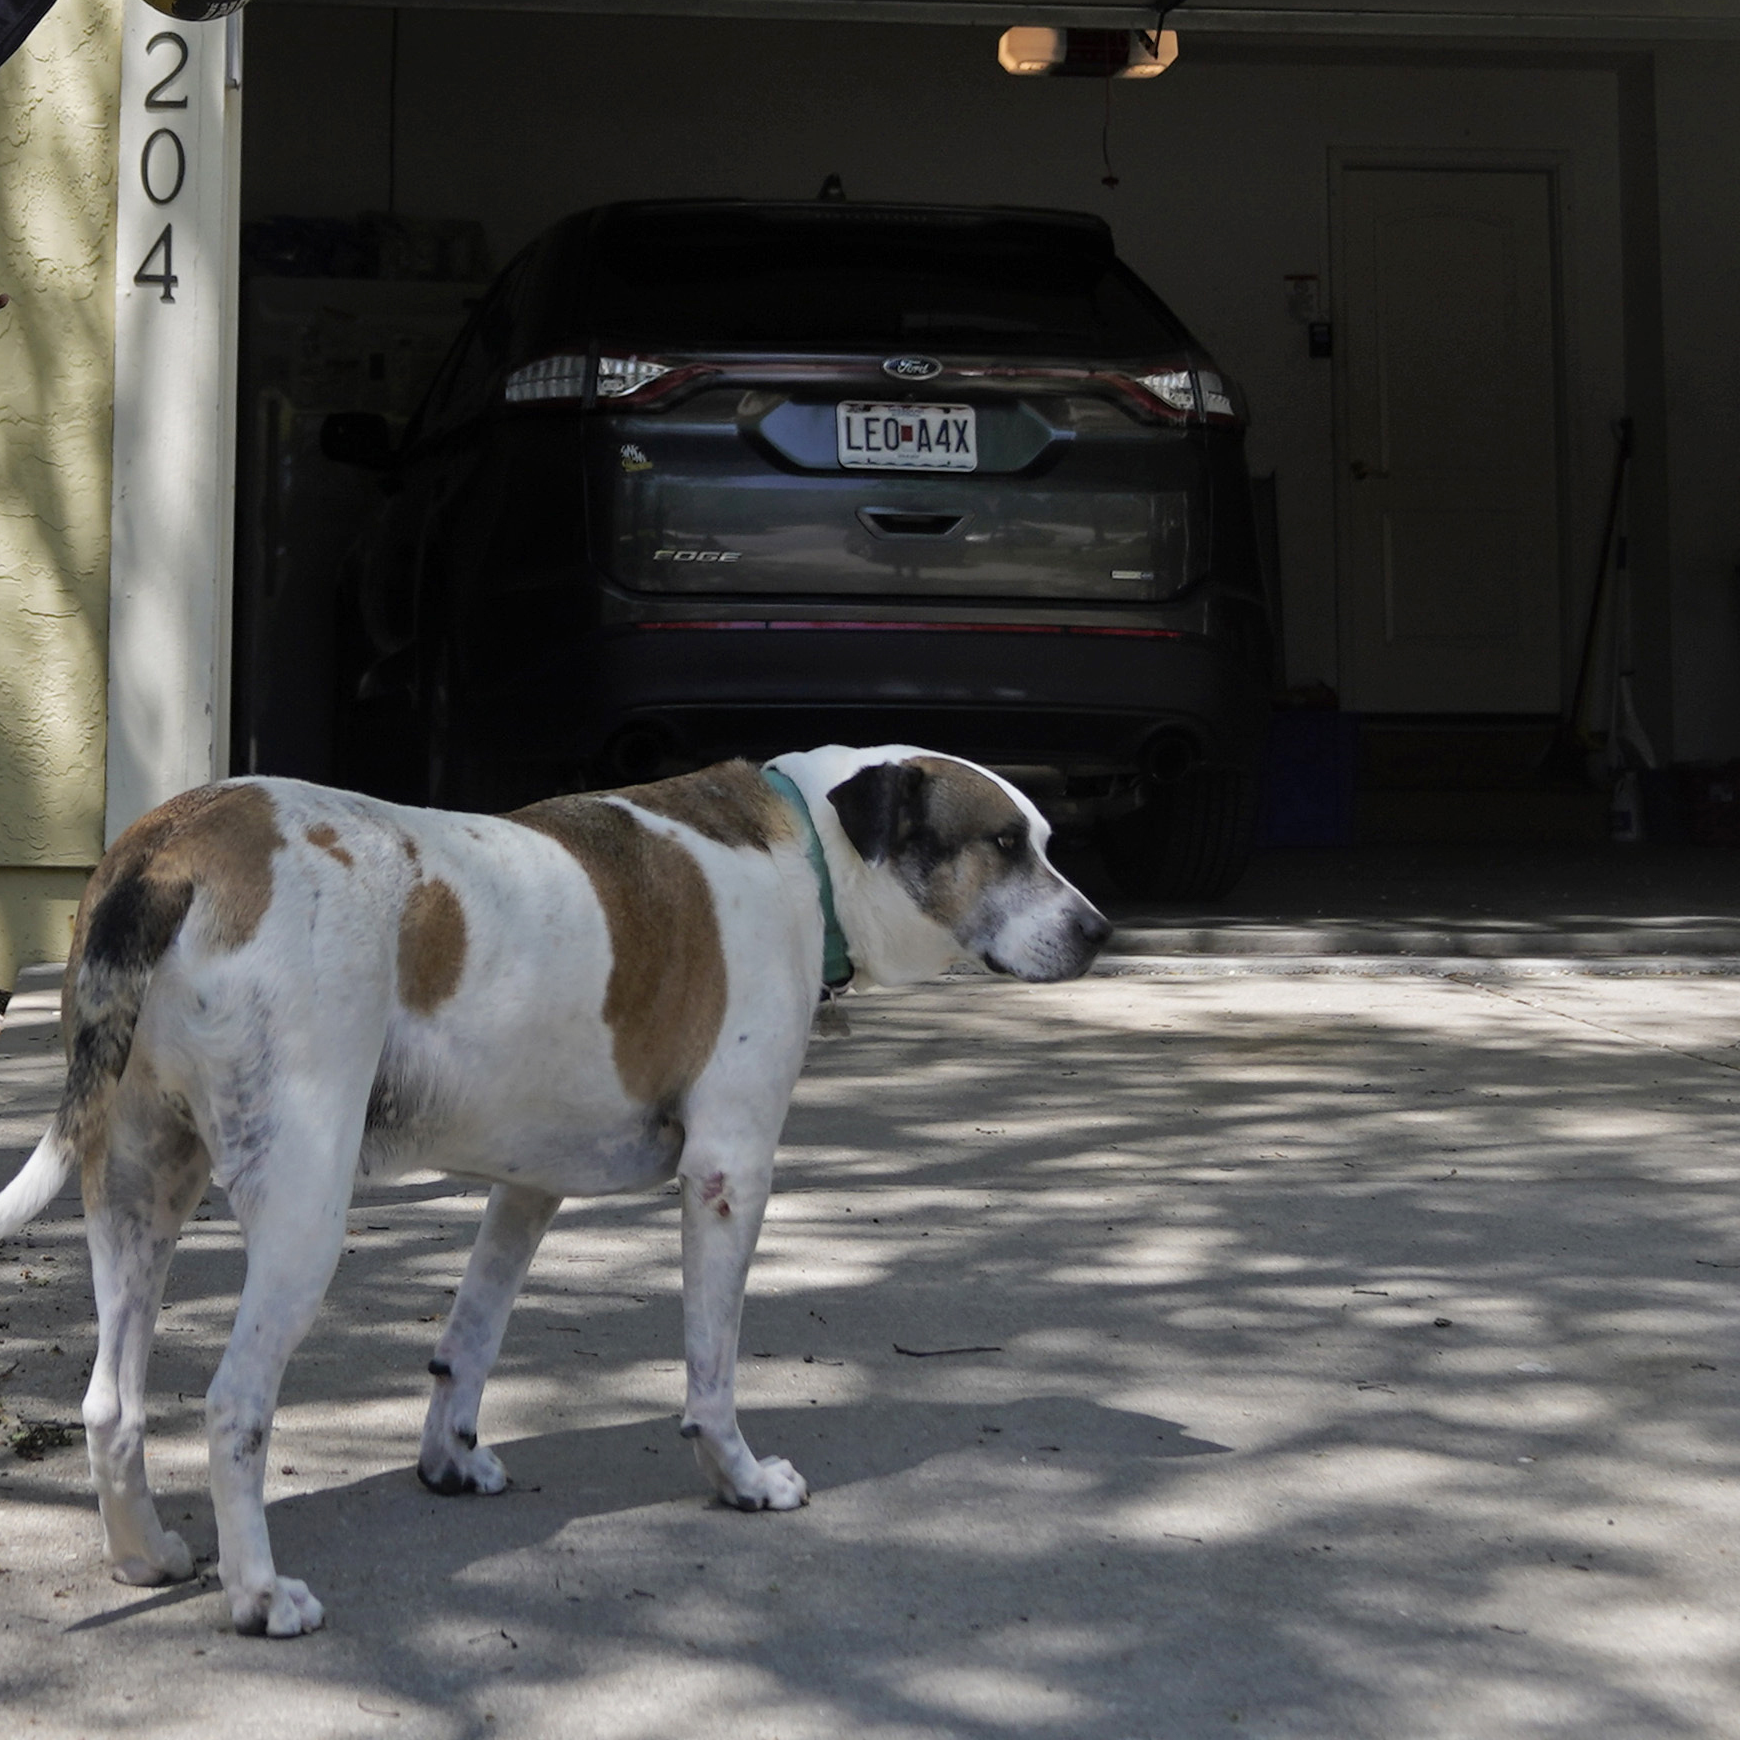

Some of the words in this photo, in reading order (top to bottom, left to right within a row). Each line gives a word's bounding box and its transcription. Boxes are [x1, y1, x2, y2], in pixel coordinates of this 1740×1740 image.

[133, 31, 189, 304] 204
[897, 359, 930, 374] Ford
[917, 418, 970, 453] A4X
[653, 550, 743, 563] EDGE
